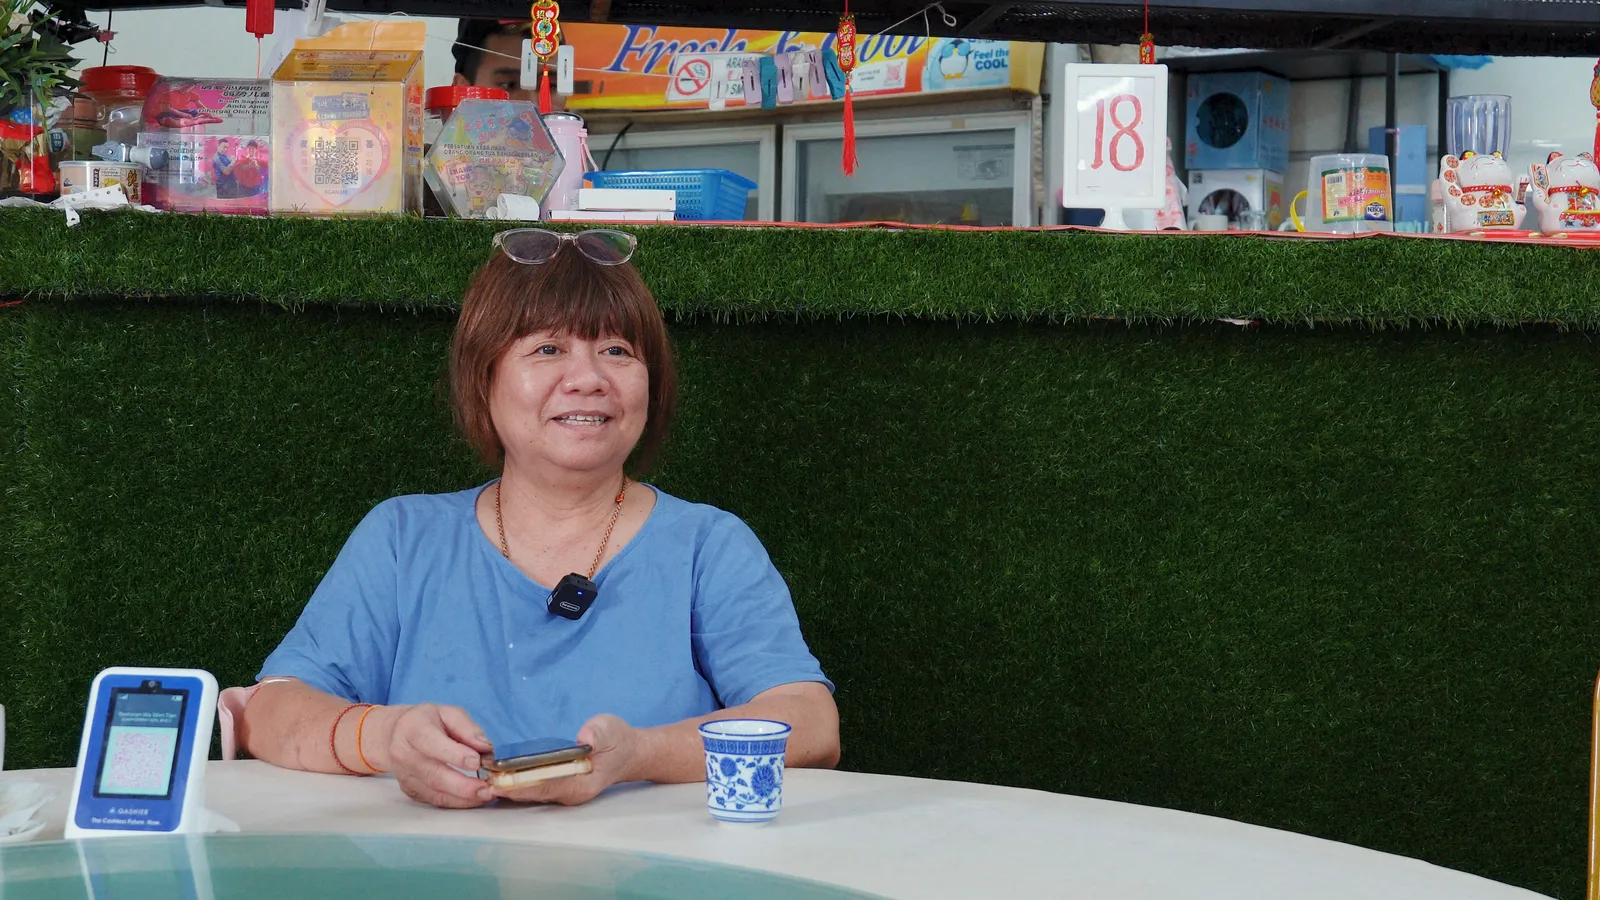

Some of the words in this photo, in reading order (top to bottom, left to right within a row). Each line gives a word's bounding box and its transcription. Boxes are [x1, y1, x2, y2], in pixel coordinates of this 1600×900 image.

[974, 49, 994, 60] Feel
[995, 48, 1010, 58] the
[975, 58, 1008, 70] COOL
[1091, 94, 1145, 172] 18
[450, 165, 474, 175] THANK
[455, 173, 471, 181] YOU
[1367, 206, 1384, 214] HOSEN
